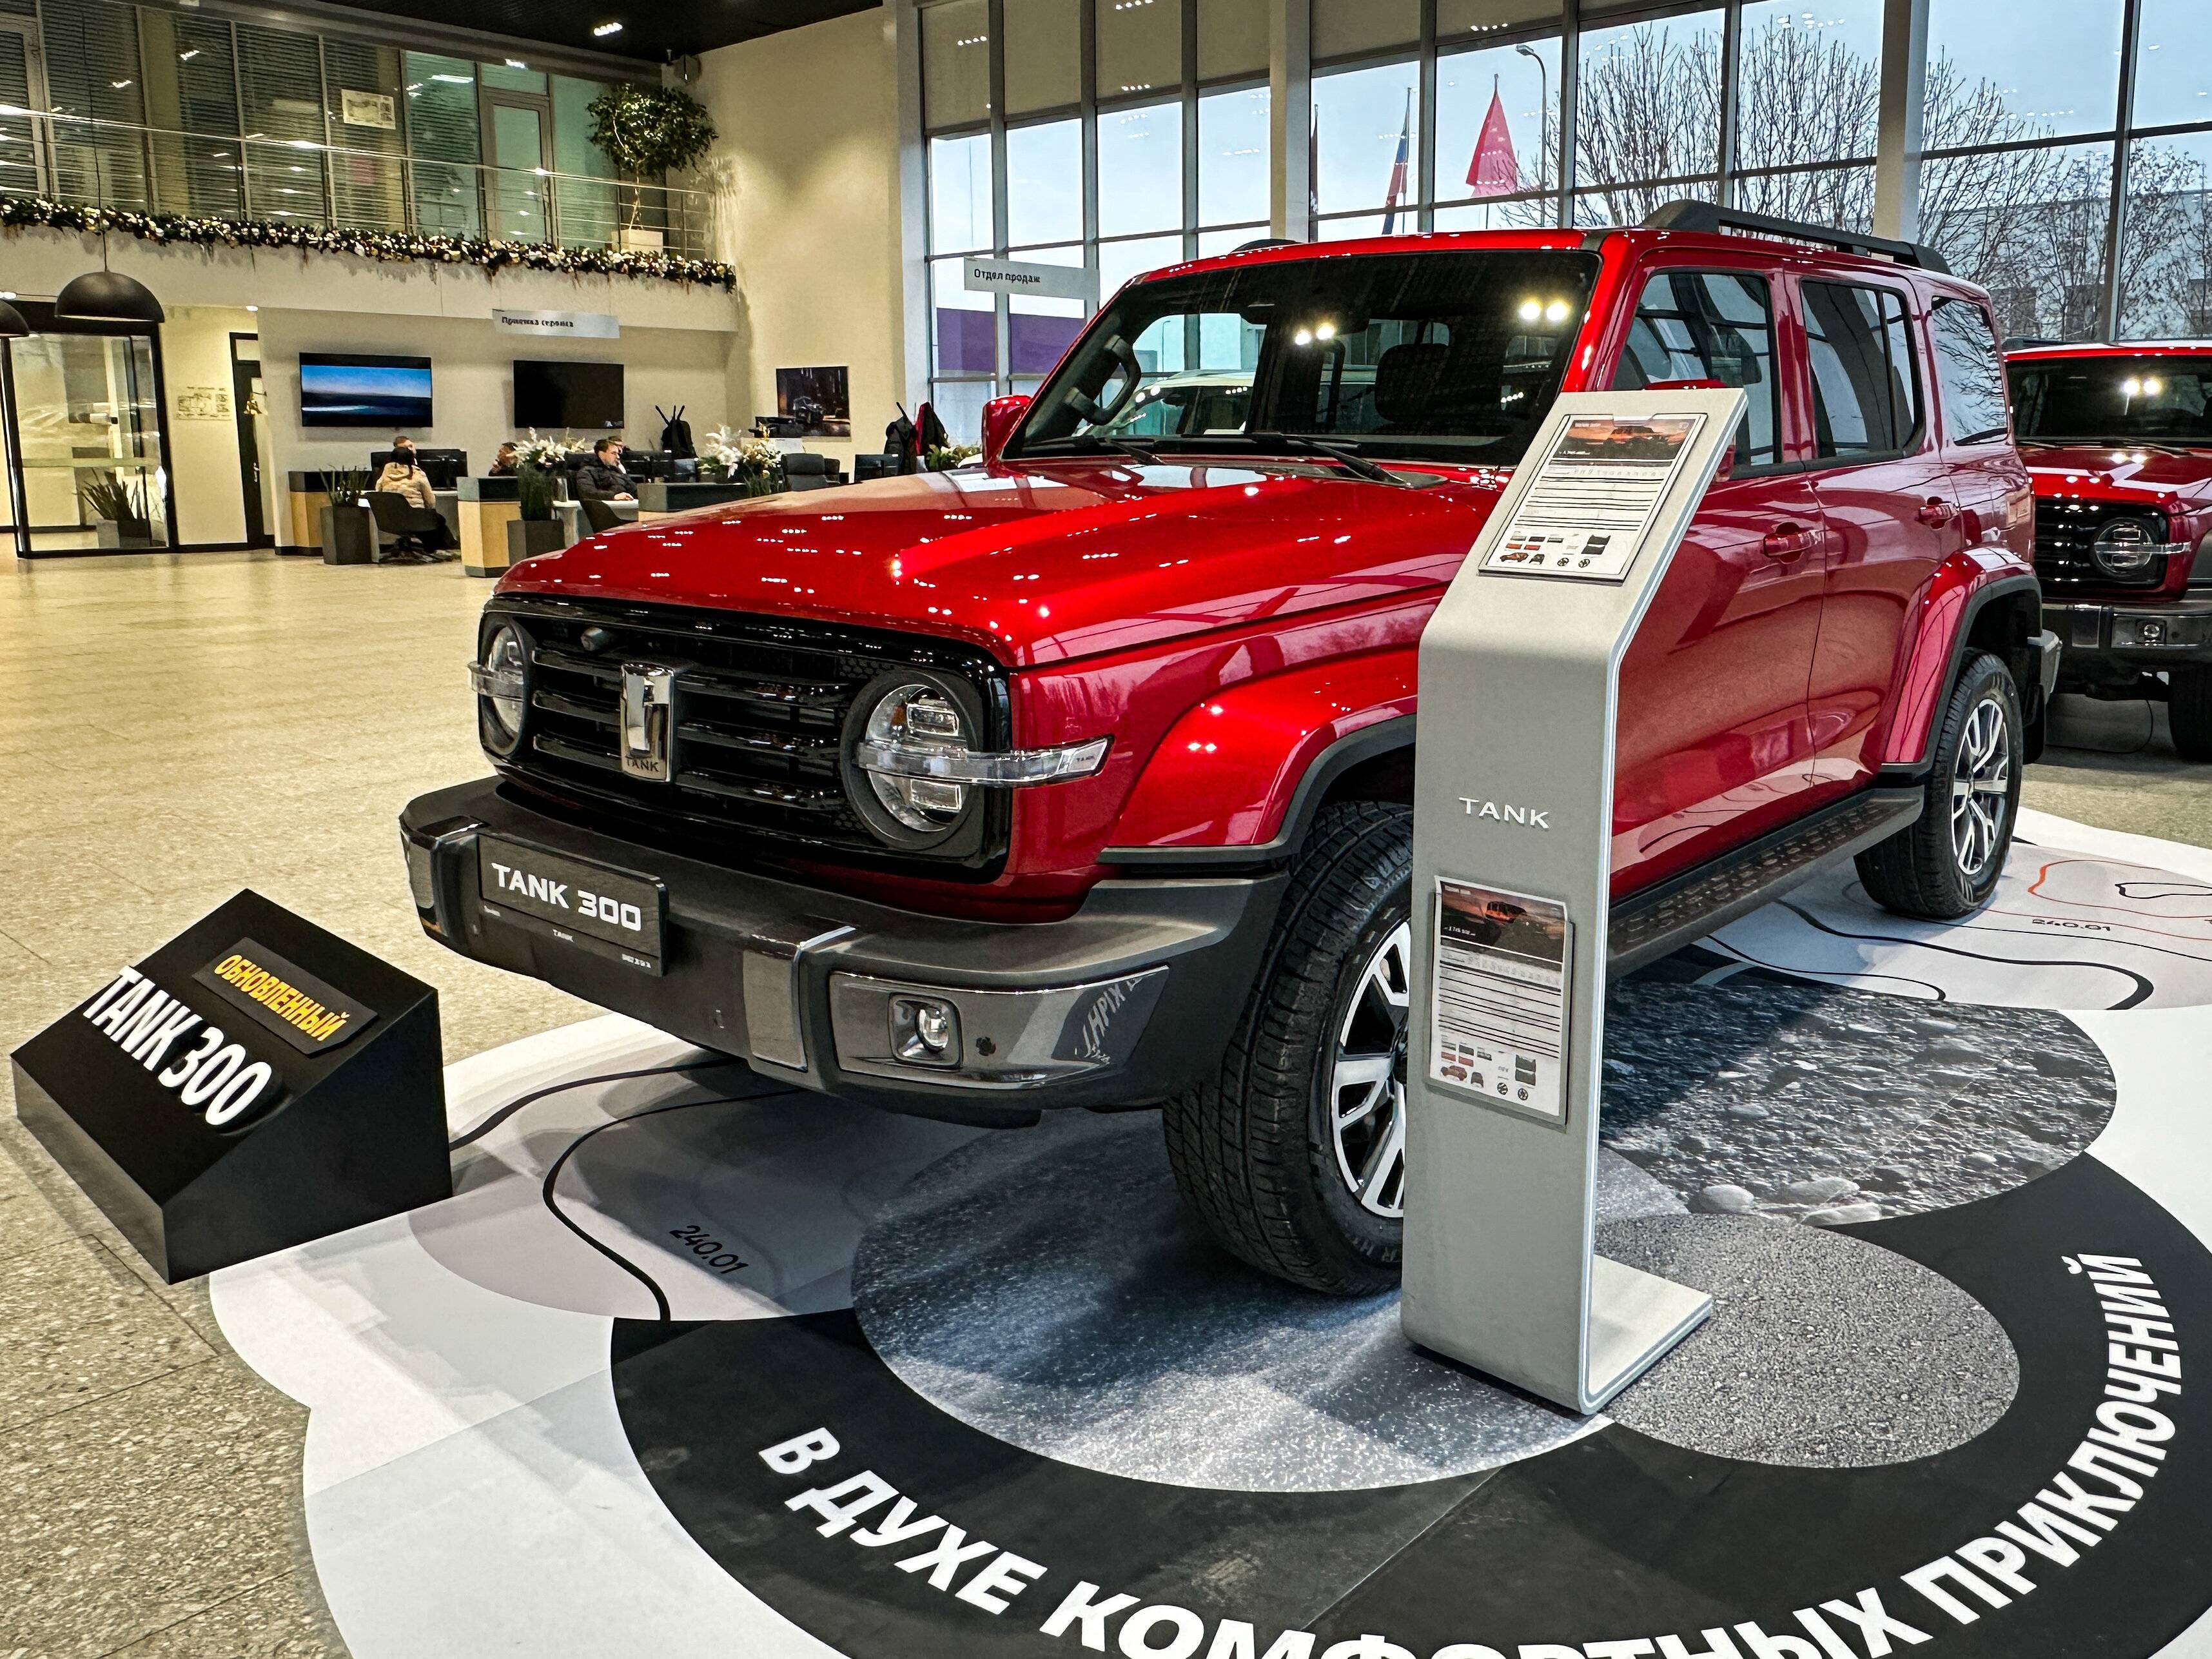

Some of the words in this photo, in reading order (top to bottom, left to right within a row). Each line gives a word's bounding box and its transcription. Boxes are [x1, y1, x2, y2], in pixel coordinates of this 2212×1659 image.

[974, 268, 1003, 281] Отдел
[1005, 273, 1041, 284] продаж
[625, 758, 660, 772] TANK
[1458, 797, 1549, 829] TANK
[491, 862, 569, 909] TANK
[578, 890, 641, 932] 300
[214, 954, 350, 1042] ОБНОВЛЕННЫЙ
[83, 965, 203, 1071] TANK
[158, 1026, 272, 1126] 300
[669, 1224, 749, 1274] 240.01
[758, 1427, 841, 1475] В
[1900, 1253, 2183, 1625] ПРИКЛЮЧЕНИЙ
[784, 1469, 1048, 1615] ДУХЕ
